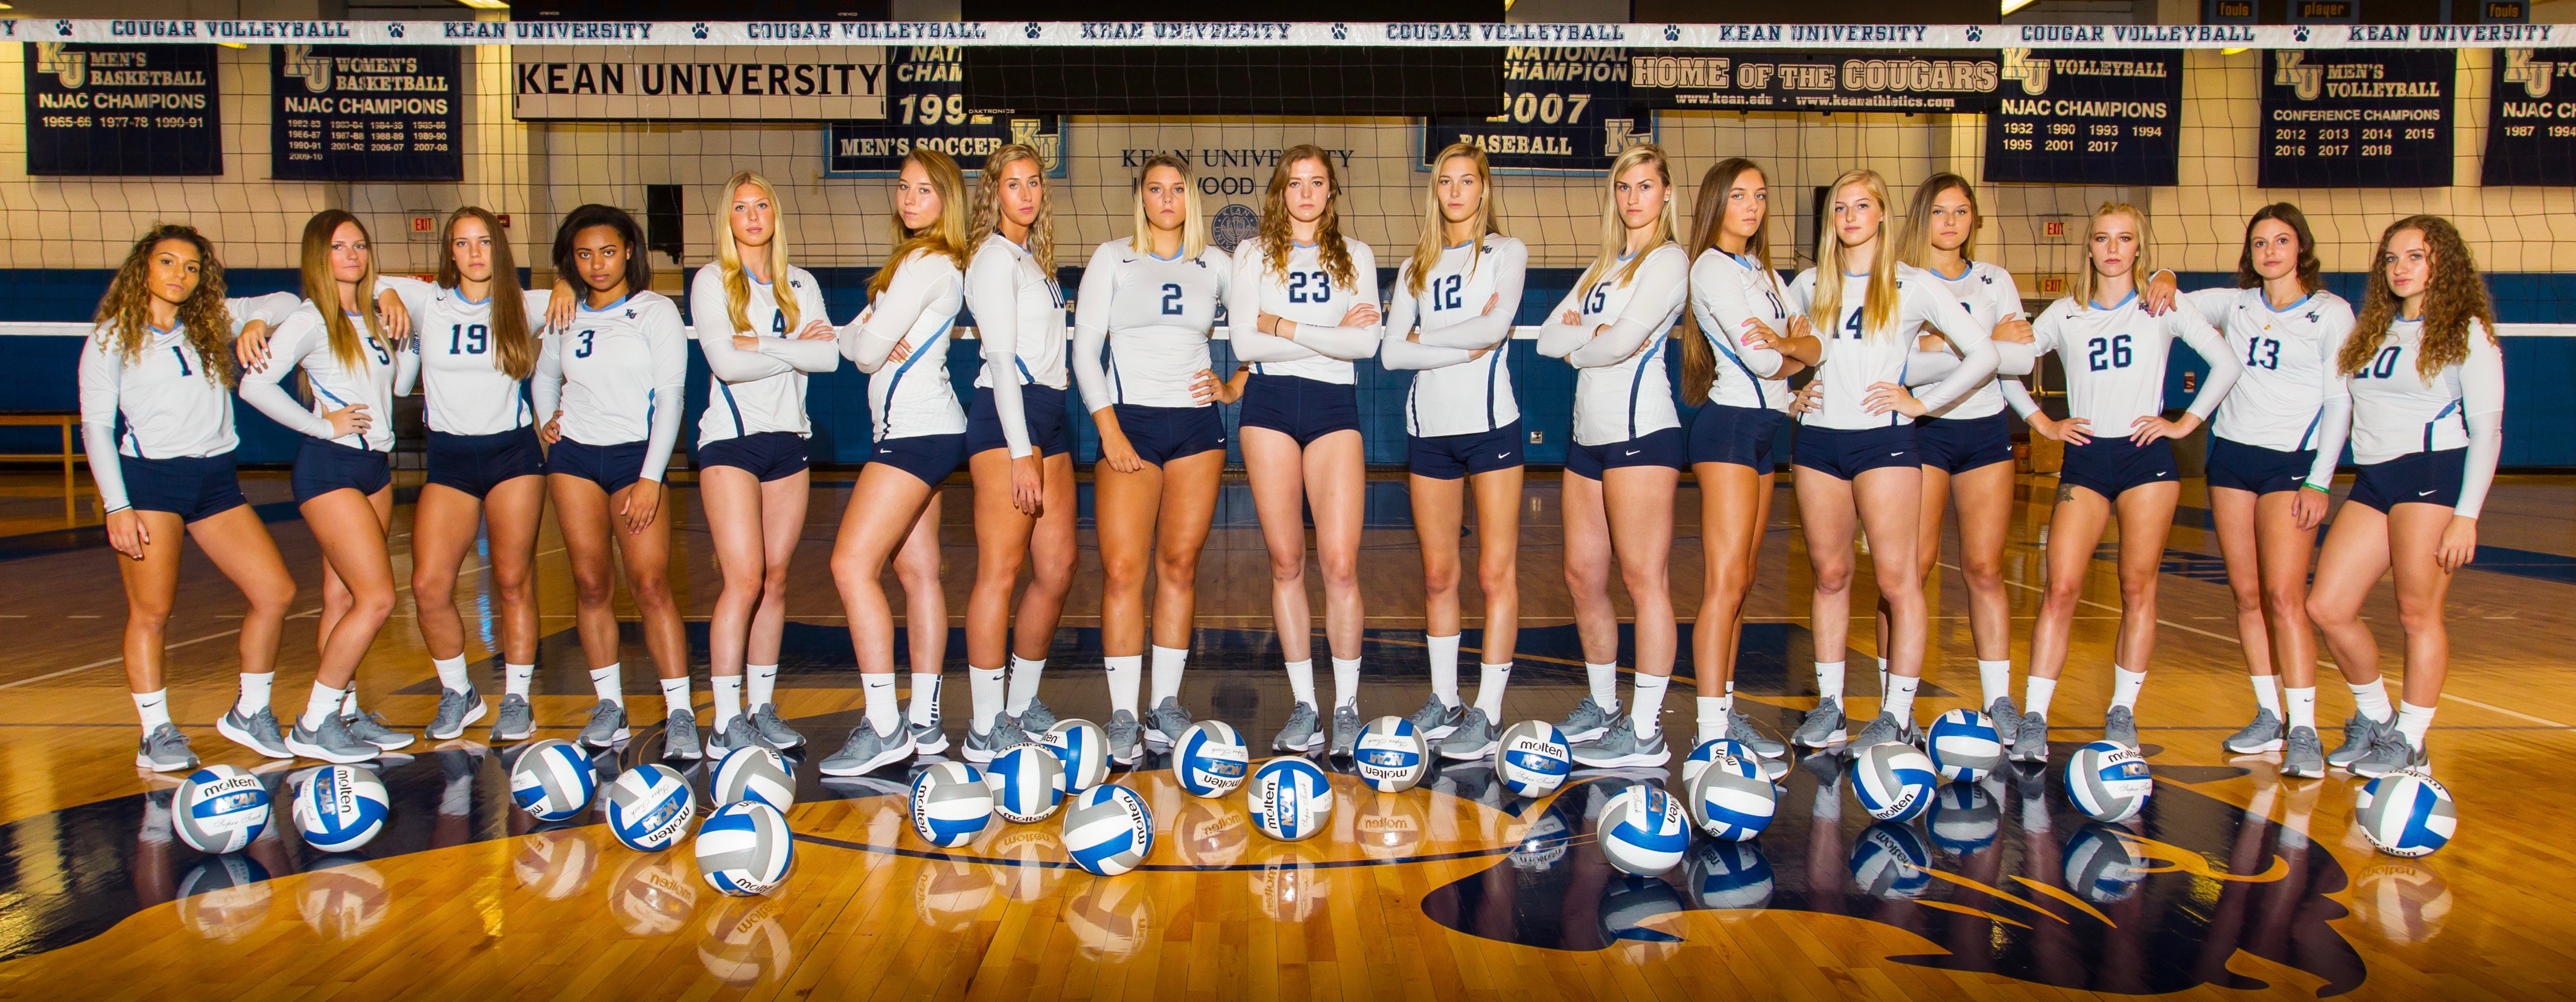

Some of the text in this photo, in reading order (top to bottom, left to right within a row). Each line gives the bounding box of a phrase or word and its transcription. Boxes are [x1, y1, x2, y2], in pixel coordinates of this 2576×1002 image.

[2221, 2, 2249, 16] fouls
[2304, 2, 2344, 16] player
[2490, 5, 2518, 17] fouls
[1, 21, 18, 37] Y
[112, 21, 351, 39] COUGAR VOLLEYBALL
[443, 22, 653, 40] KEAN UNIVERSITY
[746, 22, 987, 40] COUGAR VOLLEYBALL
[1080, 22, 1292, 40] KEAN UNIVERSITY
[1386, 23, 1625, 42] COUGAR VOLLEYBALL
[1719, 24, 1928, 42] KEAN UNIVERSITY
[2021, 25, 2256, 42] COUGAR VOLLEYBALL
[2347, 24, 2554, 42] KEAN UNIVERSITY
[91, 52, 147, 67] MEN'S
[336, 57, 417, 73] WOMEN'S
[1632, 57, 1998, 93] HOME OF THE COUGARS
[2055, 60, 2166, 77] VOLLEYBALL
[2327, 64, 2384, 79] MEN'S
[91, 71, 206, 86] BASKETBALL
[336, 75, 448, 91] BASKETBALL
[518, 63, 883, 96] KEAN UNIVERSITY
[2327, 82, 2440, 98] VOLLEYBALL
[39, 93, 206, 109] NJAC CHAMPIONS
[285, 97, 448, 115] NJAC CHAMPIONS
[1676, 94, 1955, 108] www.kean.edu www.keanathletics.com
[2002, 99, 2166, 118] NJAC CHAMPIONS
[2274, 109, 2440, 121] CONFERENCE CHAMPIONS
[2503, 102, 2552, 118] NJAC
[100, 117, 148, 127] 1977-78
[155, 117, 203, 127] 1990-91
[2047, 124, 2075, 135] 1990
[2090, 125, 2118, 136] 1993
[2132, 126, 2161, 137] 1994
[2276, 128, 2435, 139] 2012 2013 2014 2015
[2505, 126, 2535, 136] 1987
[841, 138, 1002, 156] MEN'S SOCCER
[2003, 139, 2118, 152] 1995 2001 2017
[2275, 145, 2392, 156] 2016 2017 2018
[415, 218, 431, 231] EXIT
[2048, 223, 2064, 235] EXIT
[1289, 271, 1331, 303] 23
[1433, 274, 1461, 311] 12
[2045, 279, 2062, 293] EXIT
[1162, 283, 1183, 315] 2
[1583, 282, 1612, 315] 15
[1766, 290, 1786, 319] 11
[625, 309, 637, 320] KU
[2305, 311, 2320, 323] KU
[450, 324, 488, 355] 19
[575, 329, 596, 359] 3
[171, 346, 192, 377] 1
[2088, 334, 2132, 372] 26
[2247, 337, 2280, 371] 13
[1520, 741, 1563, 758] molten
[2108, 750, 2140, 763] molte
[1366, 766, 1408, 778] molten
[204, 778, 256, 797] molten
[1204, 775, 1242, 789] molten
[337, 770, 352, 814] molten
[915, 785, 927, 834] molten
[1264, 782, 1278, 830] molten
[1877, 793, 1914, 820] molten
[649, 806, 690, 845] molten
[1003, 813, 1051, 822] molten
[1124, 796, 1145, 845] molten
[2365, 834, 2417, 856] molten
